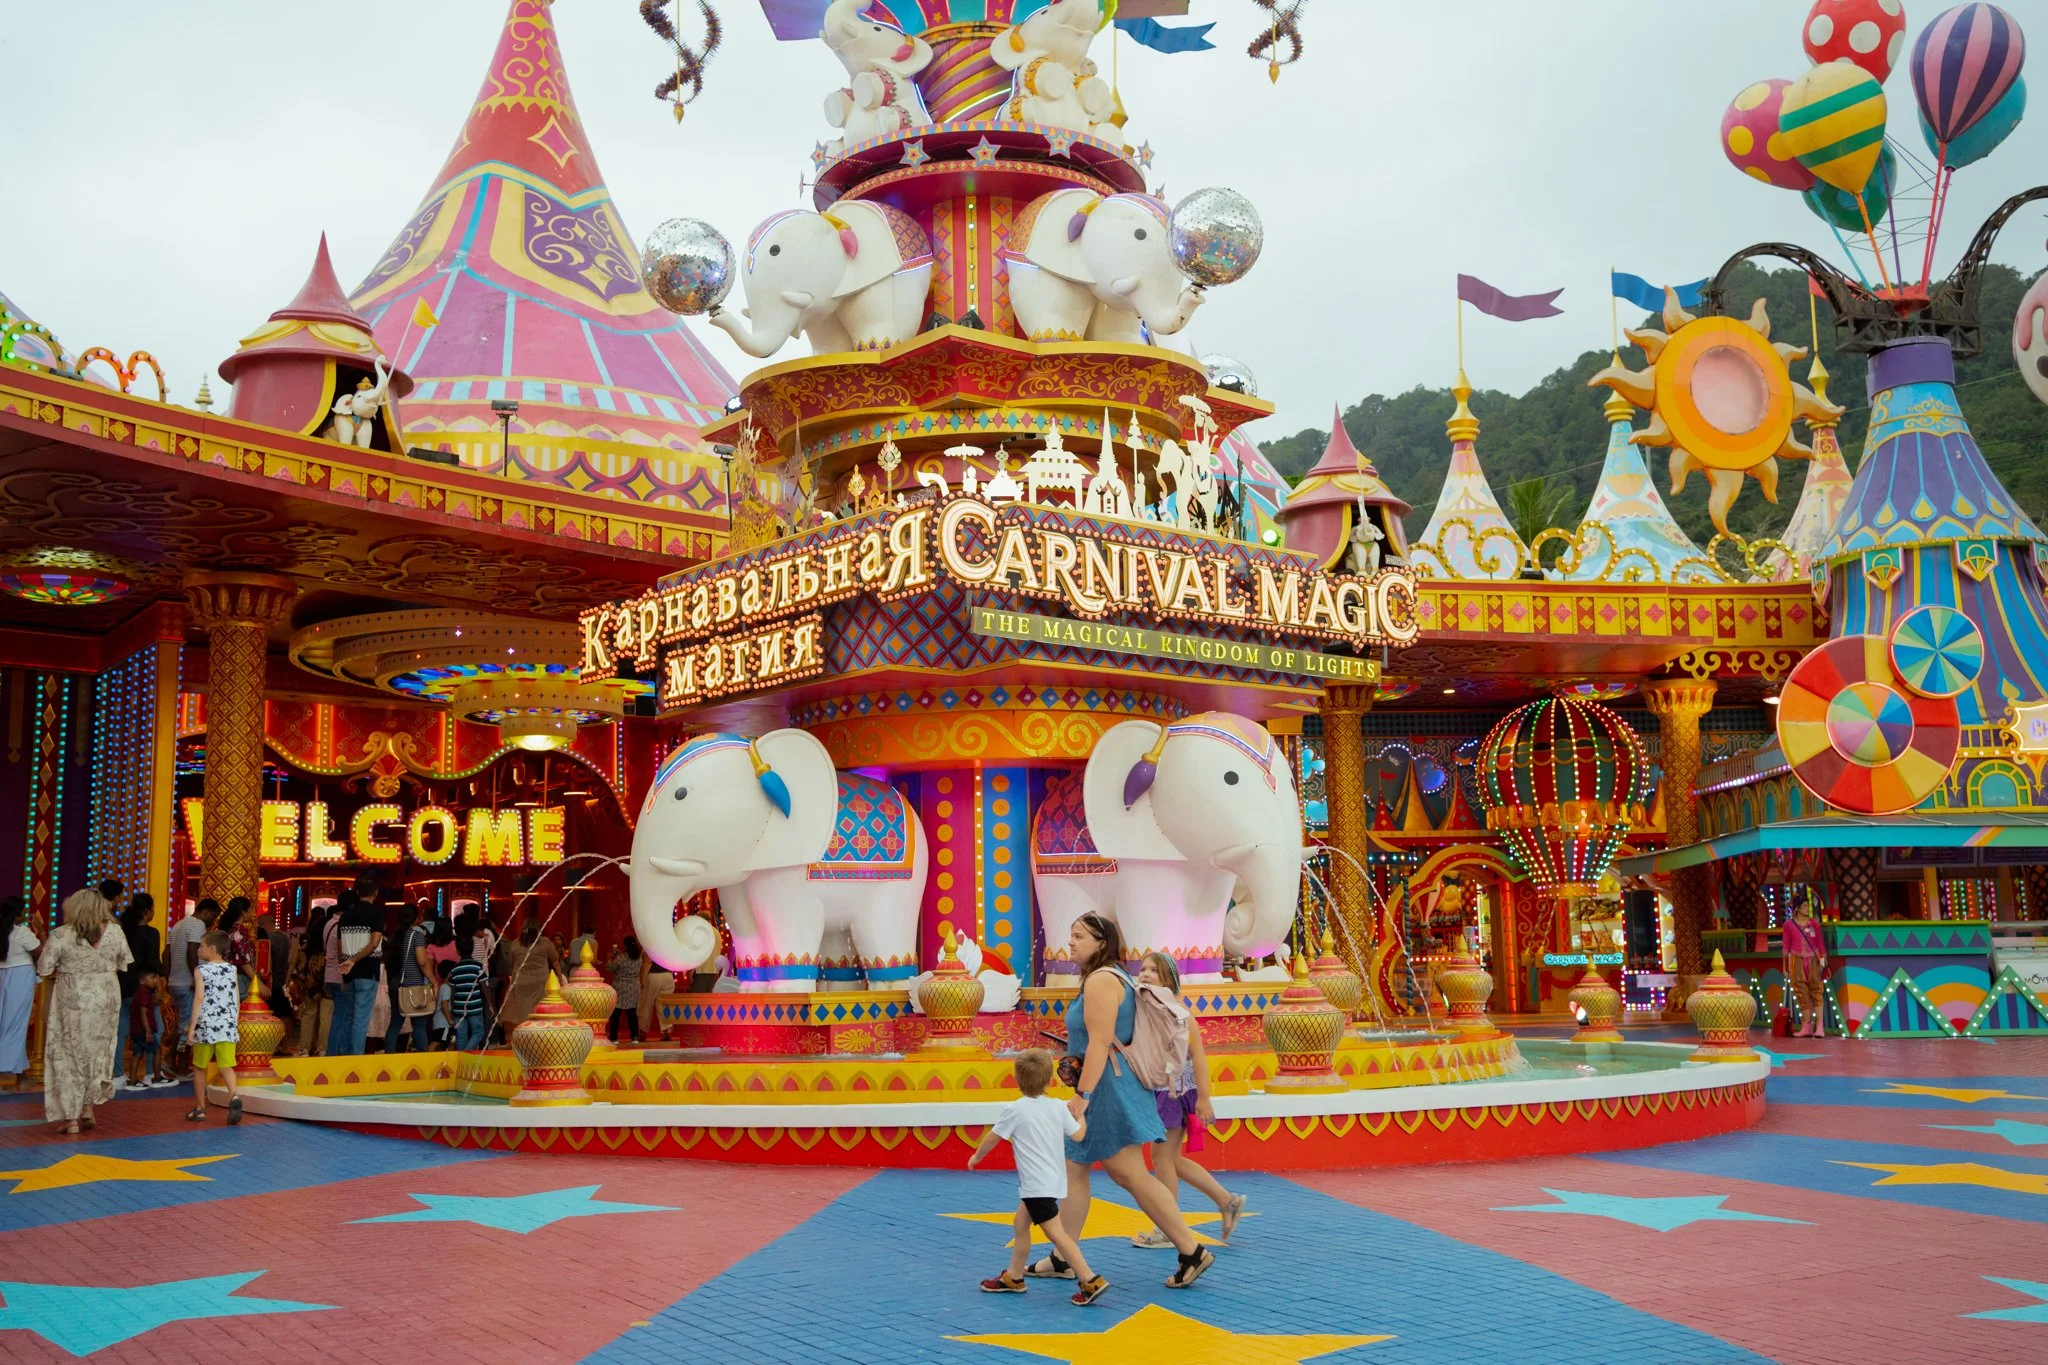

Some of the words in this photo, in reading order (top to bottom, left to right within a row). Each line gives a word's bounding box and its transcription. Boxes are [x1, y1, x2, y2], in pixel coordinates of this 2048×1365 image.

[937, 496, 1249, 618] CARNIVAL
[1256, 564, 1420, 644] MAGIC
[982, 611, 1030, 635] THE
[1043, 619, 1148, 650] MAGICAL
[1160, 635, 1260, 664] KINGDOM
[1270, 650, 1296, 668] OF
[1305, 654, 1376, 679] LIGHTS
[1543, 953, 1589, 966] CARNIVAL
[1593, 951, 1624, 965] MAGIC
